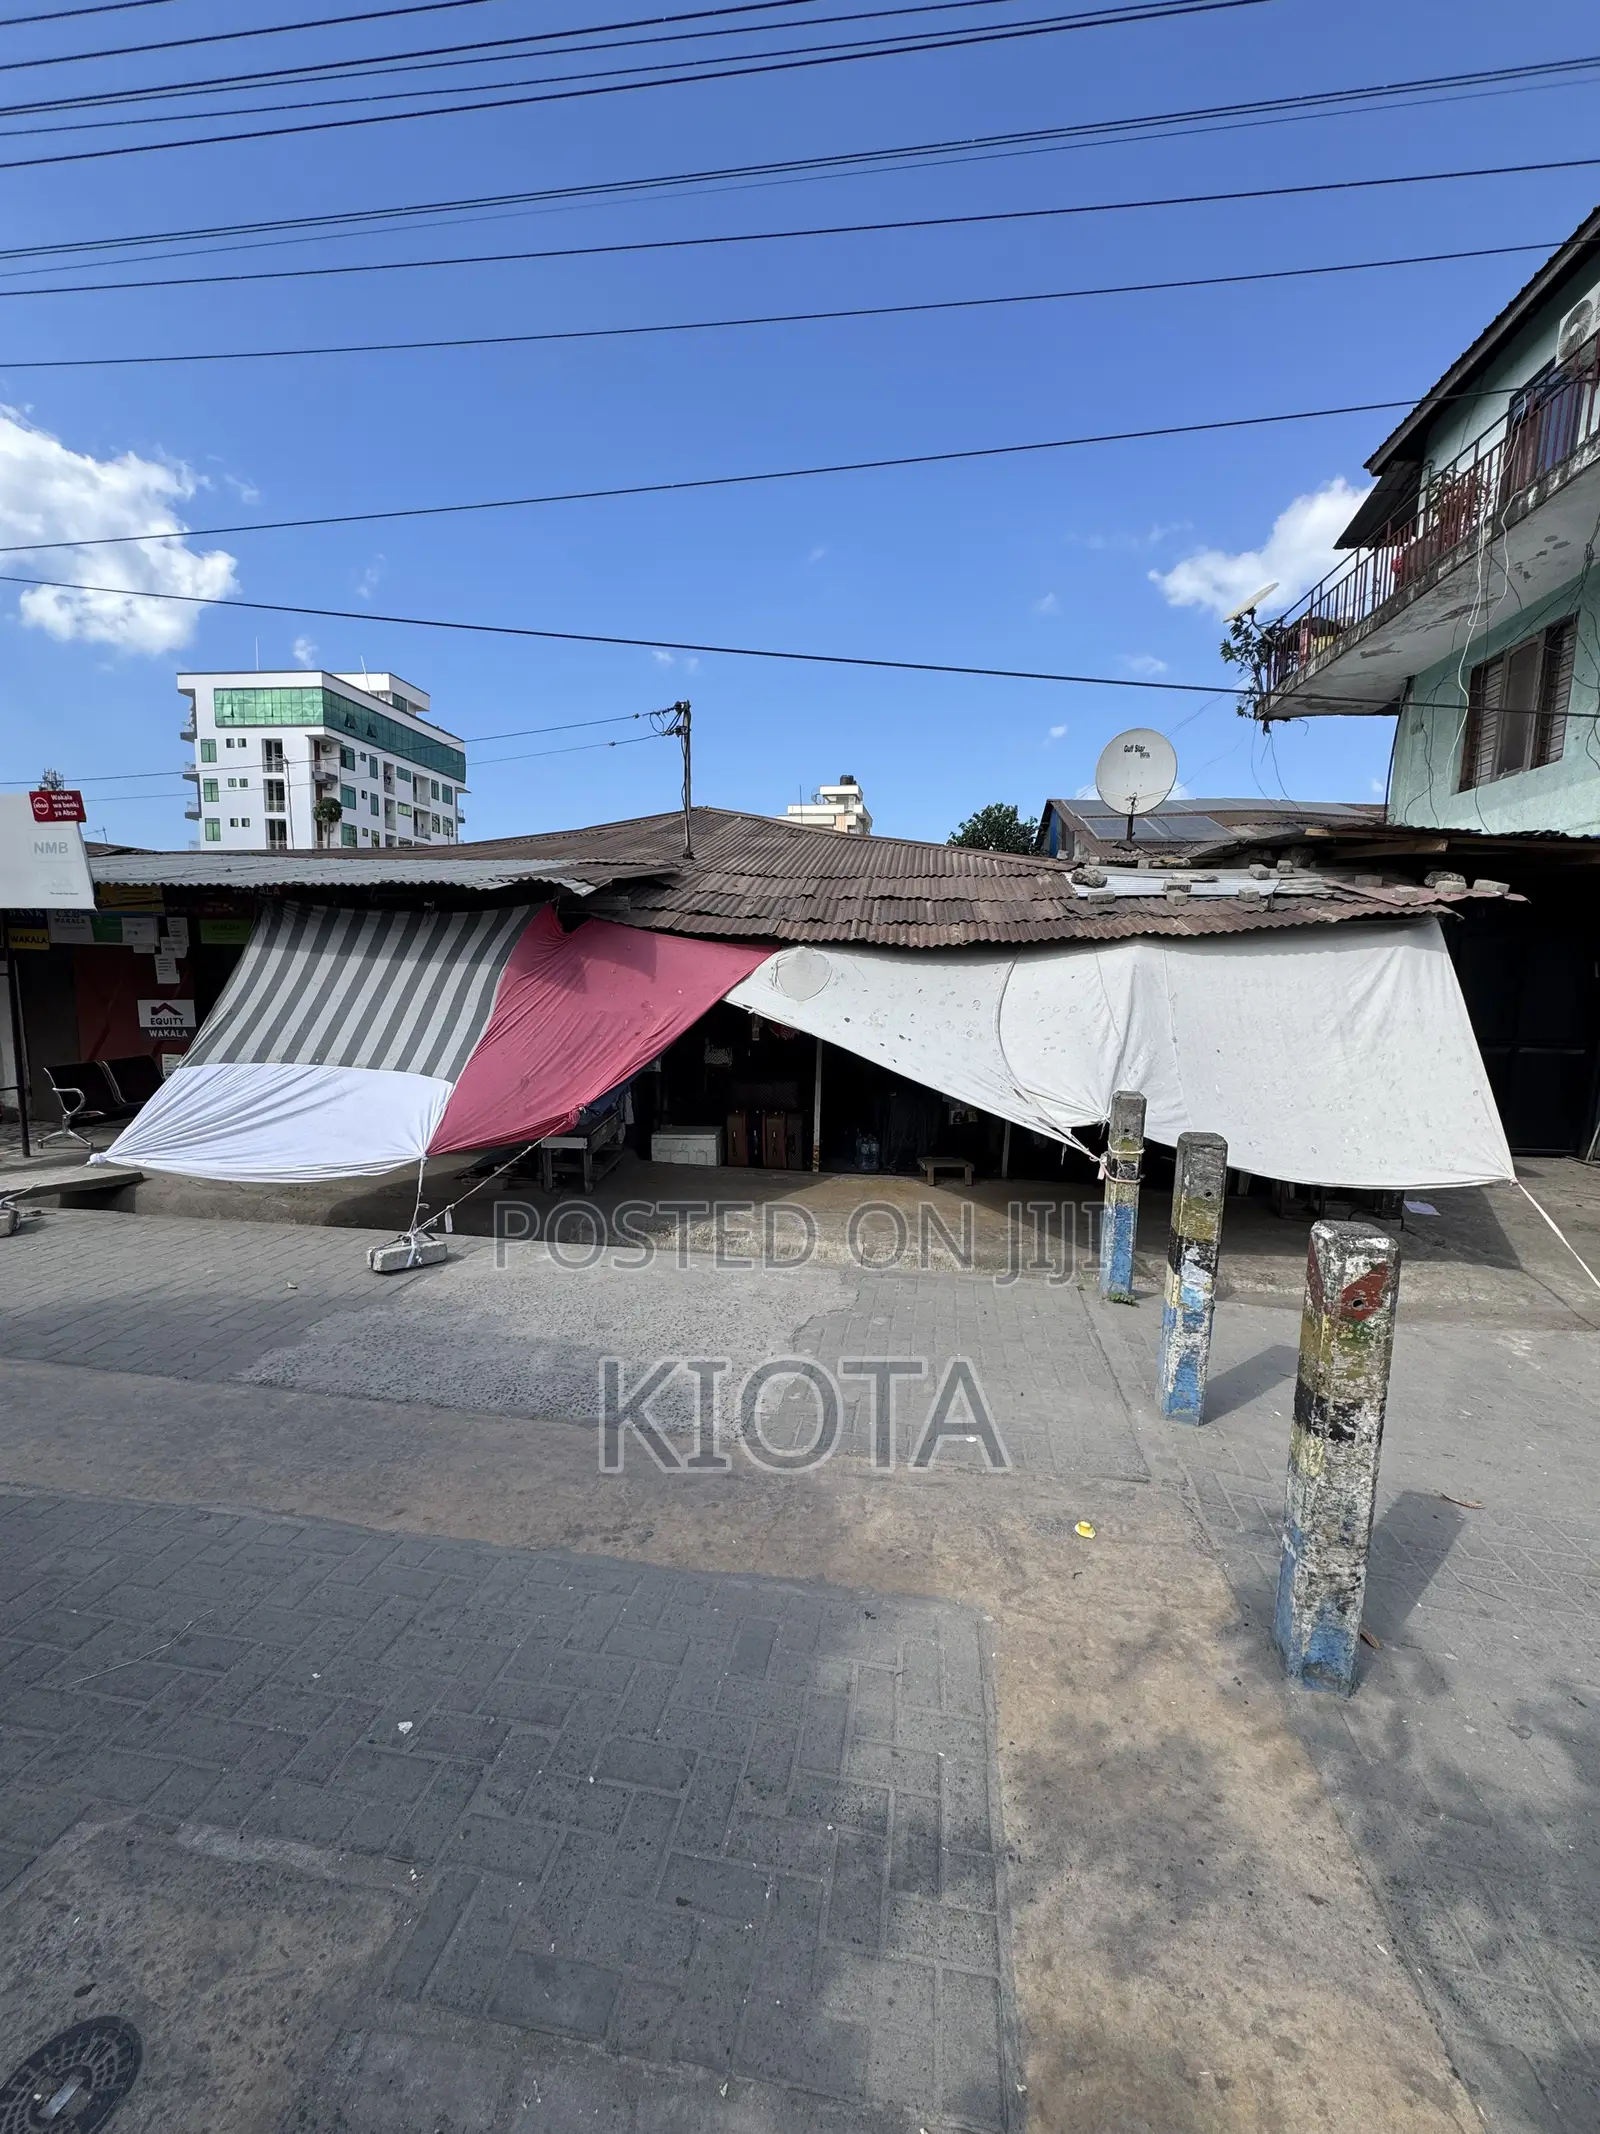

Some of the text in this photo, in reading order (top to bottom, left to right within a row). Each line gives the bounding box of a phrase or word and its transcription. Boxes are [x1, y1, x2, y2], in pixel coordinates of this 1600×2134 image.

[50, 793, 73, 801] Wakala
[62, 801, 80, 809] benki
[34, 841, 69, 854] NMB
[10, 935, 48, 944] WAKALA
[150, 1017, 184, 1026] EQUITY
[148, 1029, 188, 1038] WAKALA
